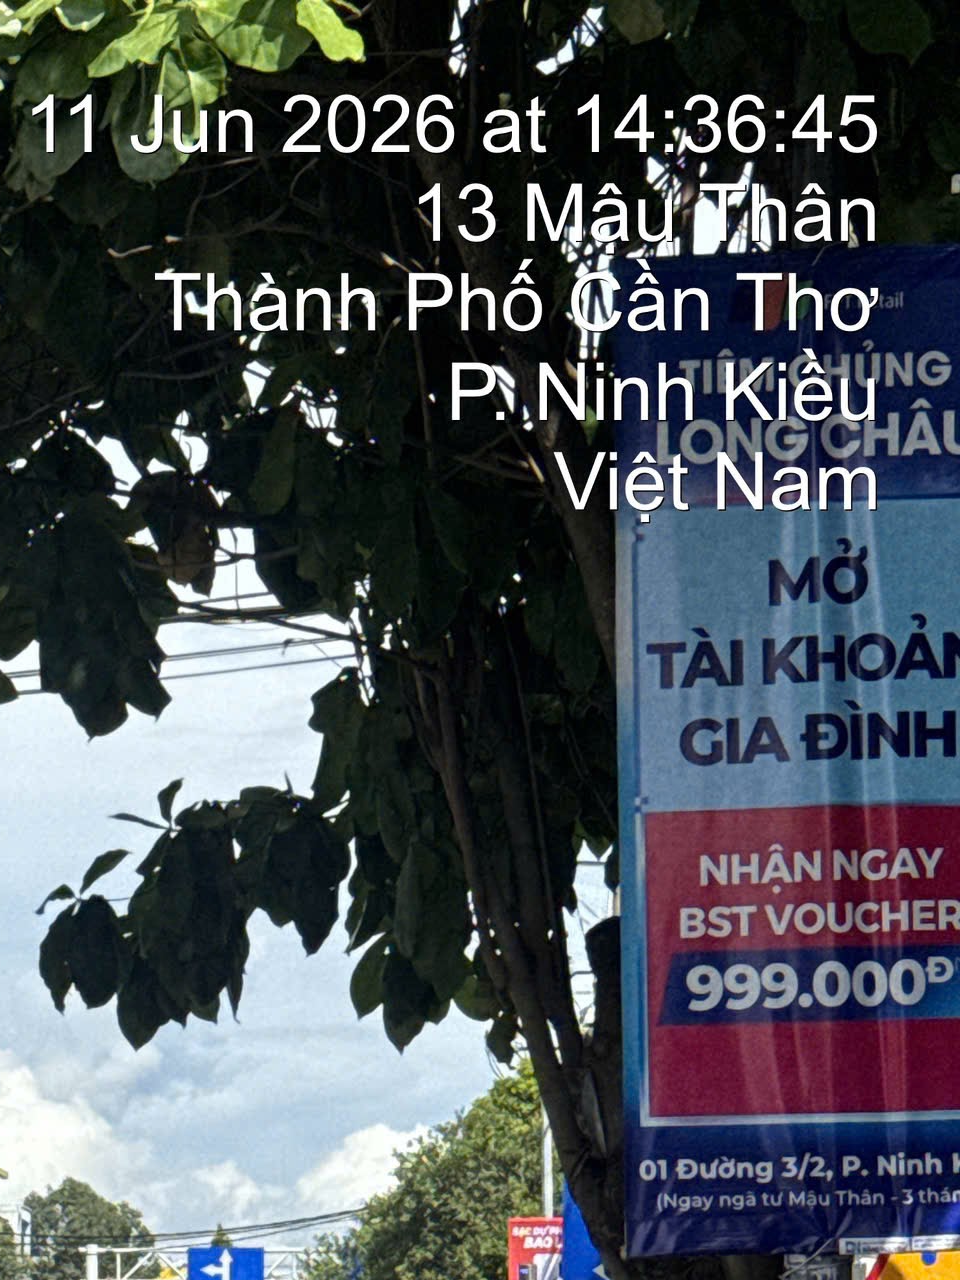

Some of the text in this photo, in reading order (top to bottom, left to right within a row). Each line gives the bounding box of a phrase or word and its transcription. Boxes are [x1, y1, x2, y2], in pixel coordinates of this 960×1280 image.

[656, 415, 809, 465] LONG
[768, 537, 868, 606] MỞ
[646, 627, 744, 689] TÀI
[679, 700, 956, 766] GIA ĐÌNH
[699, 843, 944, 894] NHẬN NGAY
[679, 899, 960, 938] BST VOUCHER
[640, 1159, 668, 1180] 01
[676, 1156, 774, 1184] Đường
[781, 1152, 834, 1181] 3/2,
[842, 1156, 869, 1177] P.
[877, 1152, 943, 1177] Ninh
[656, 1192, 714, 1213] (Ngay
[719, 1189, 756, 1210] ngã
[762, 1190, 783, 1207] tư
[835, 1188, 885, 1205] Thân
[902, 1188, 914, 1205] 3
